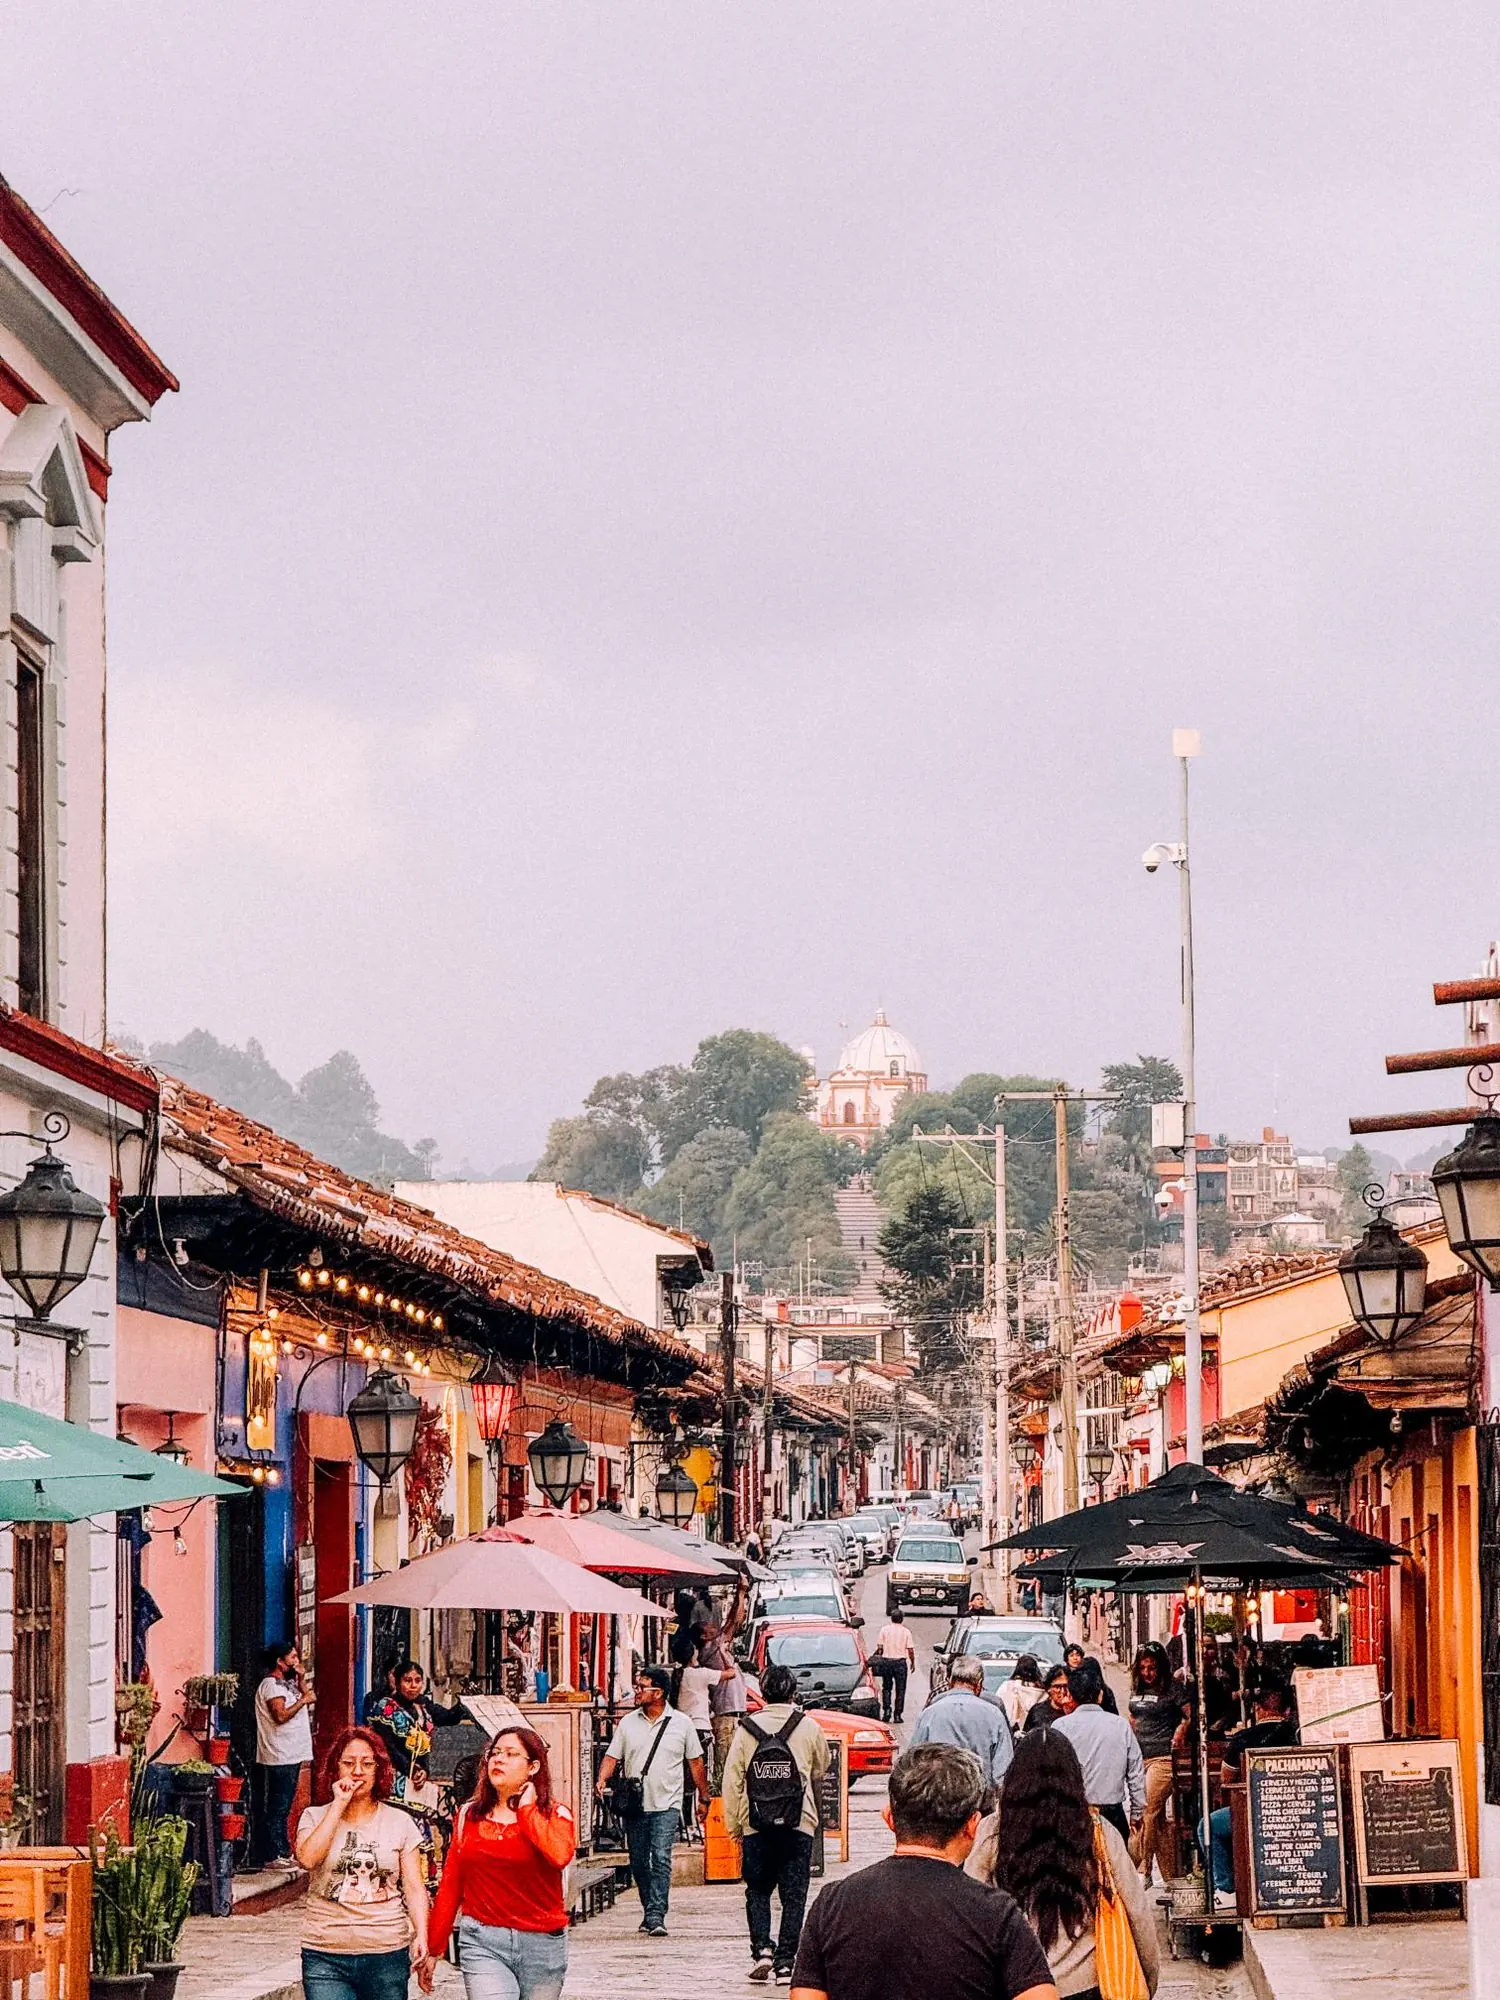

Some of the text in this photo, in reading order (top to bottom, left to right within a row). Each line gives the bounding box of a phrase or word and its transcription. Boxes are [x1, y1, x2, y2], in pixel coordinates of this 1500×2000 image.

[1265, 1757, 1329, 1772] PACHAMAMA
[752, 1761, 791, 1779] VANS
[1260, 1779, 1288, 1787] CERVEZA
[1295, 1778, 1318, 1786] MEZCAL
[1261, 1801, 1282, 1809] PIZZA
[1287, 1800, 1316, 1808] CERVEZA
[1261, 1808, 1281, 1816] PAPAS
[1268, 1815, 1300, 1823] CERVEZAS
[1262, 1830, 1292, 1838] CALZONE
[1298, 1829, 1314, 1837] VINO
[1263, 1843, 1280, 1851] VINO
[1295, 1842, 1322, 1850] CUARTO
[1283, 1857, 1304, 1865] LIBRE
[1279, 1864, 1307, 1872] MEZCAL
[1297, 1871, 1328, 1879] TEQUILA
[1296, 1879, 1323, 1887] BRANCA
[1279, 1886, 1321, 1895] MICHELADAS
